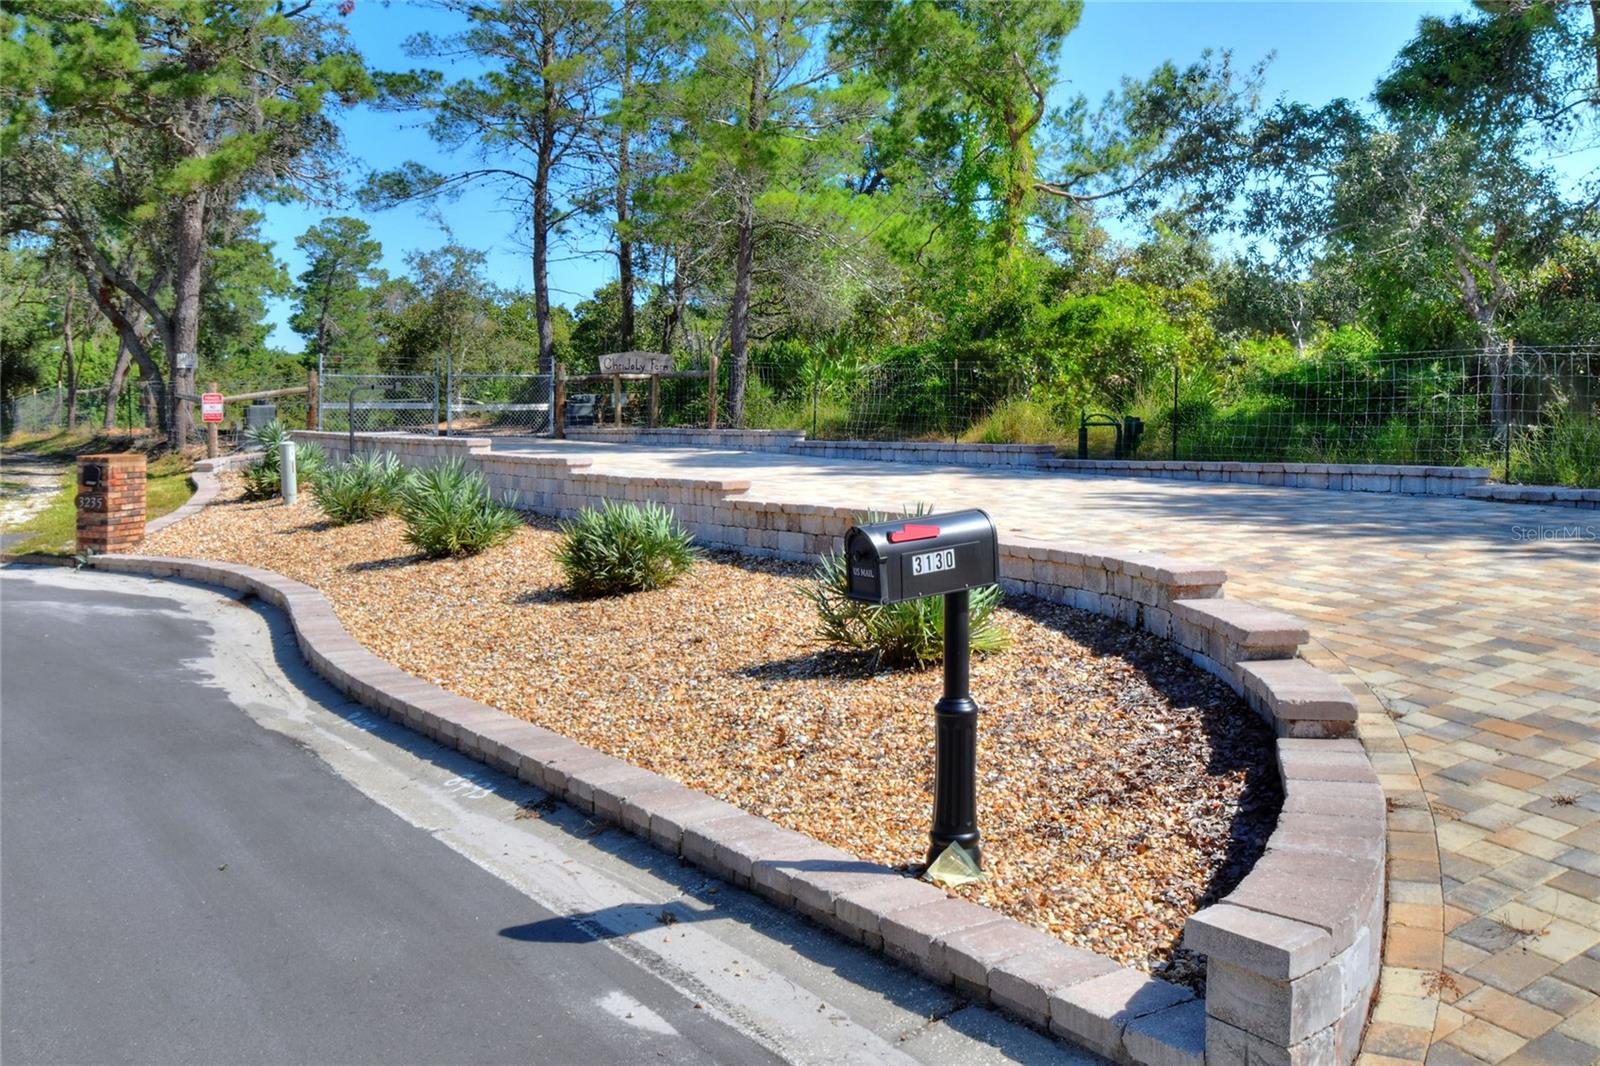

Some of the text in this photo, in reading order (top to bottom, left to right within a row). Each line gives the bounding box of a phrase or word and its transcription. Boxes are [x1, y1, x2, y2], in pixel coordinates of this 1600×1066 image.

[79, 496, 103, 509] 3235
[914, 550, 953, 574] 3130
[853, 568, 874, 578] US MAIL
